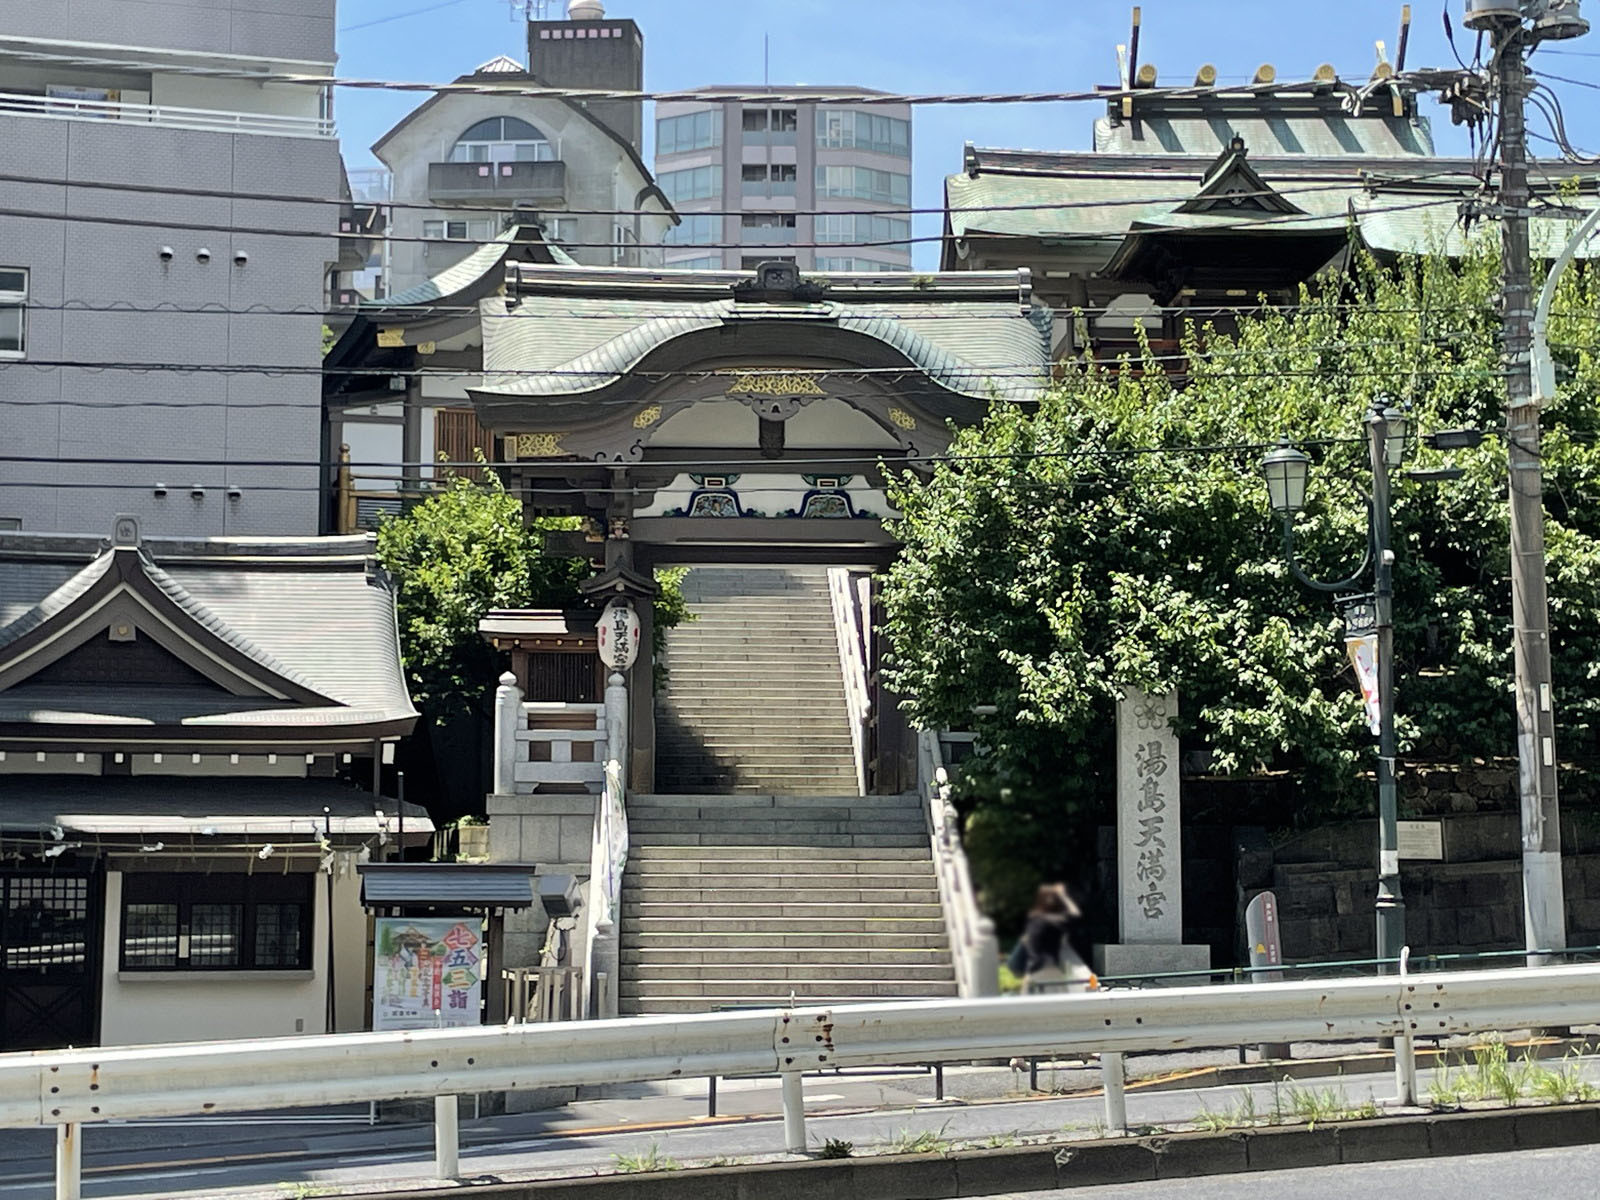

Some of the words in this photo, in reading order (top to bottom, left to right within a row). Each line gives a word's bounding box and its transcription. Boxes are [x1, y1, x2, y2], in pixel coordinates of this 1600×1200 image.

[1134, 741, 1167, 919] 湯島天満宮
[447, 925, 472, 1010] 七五三詣
